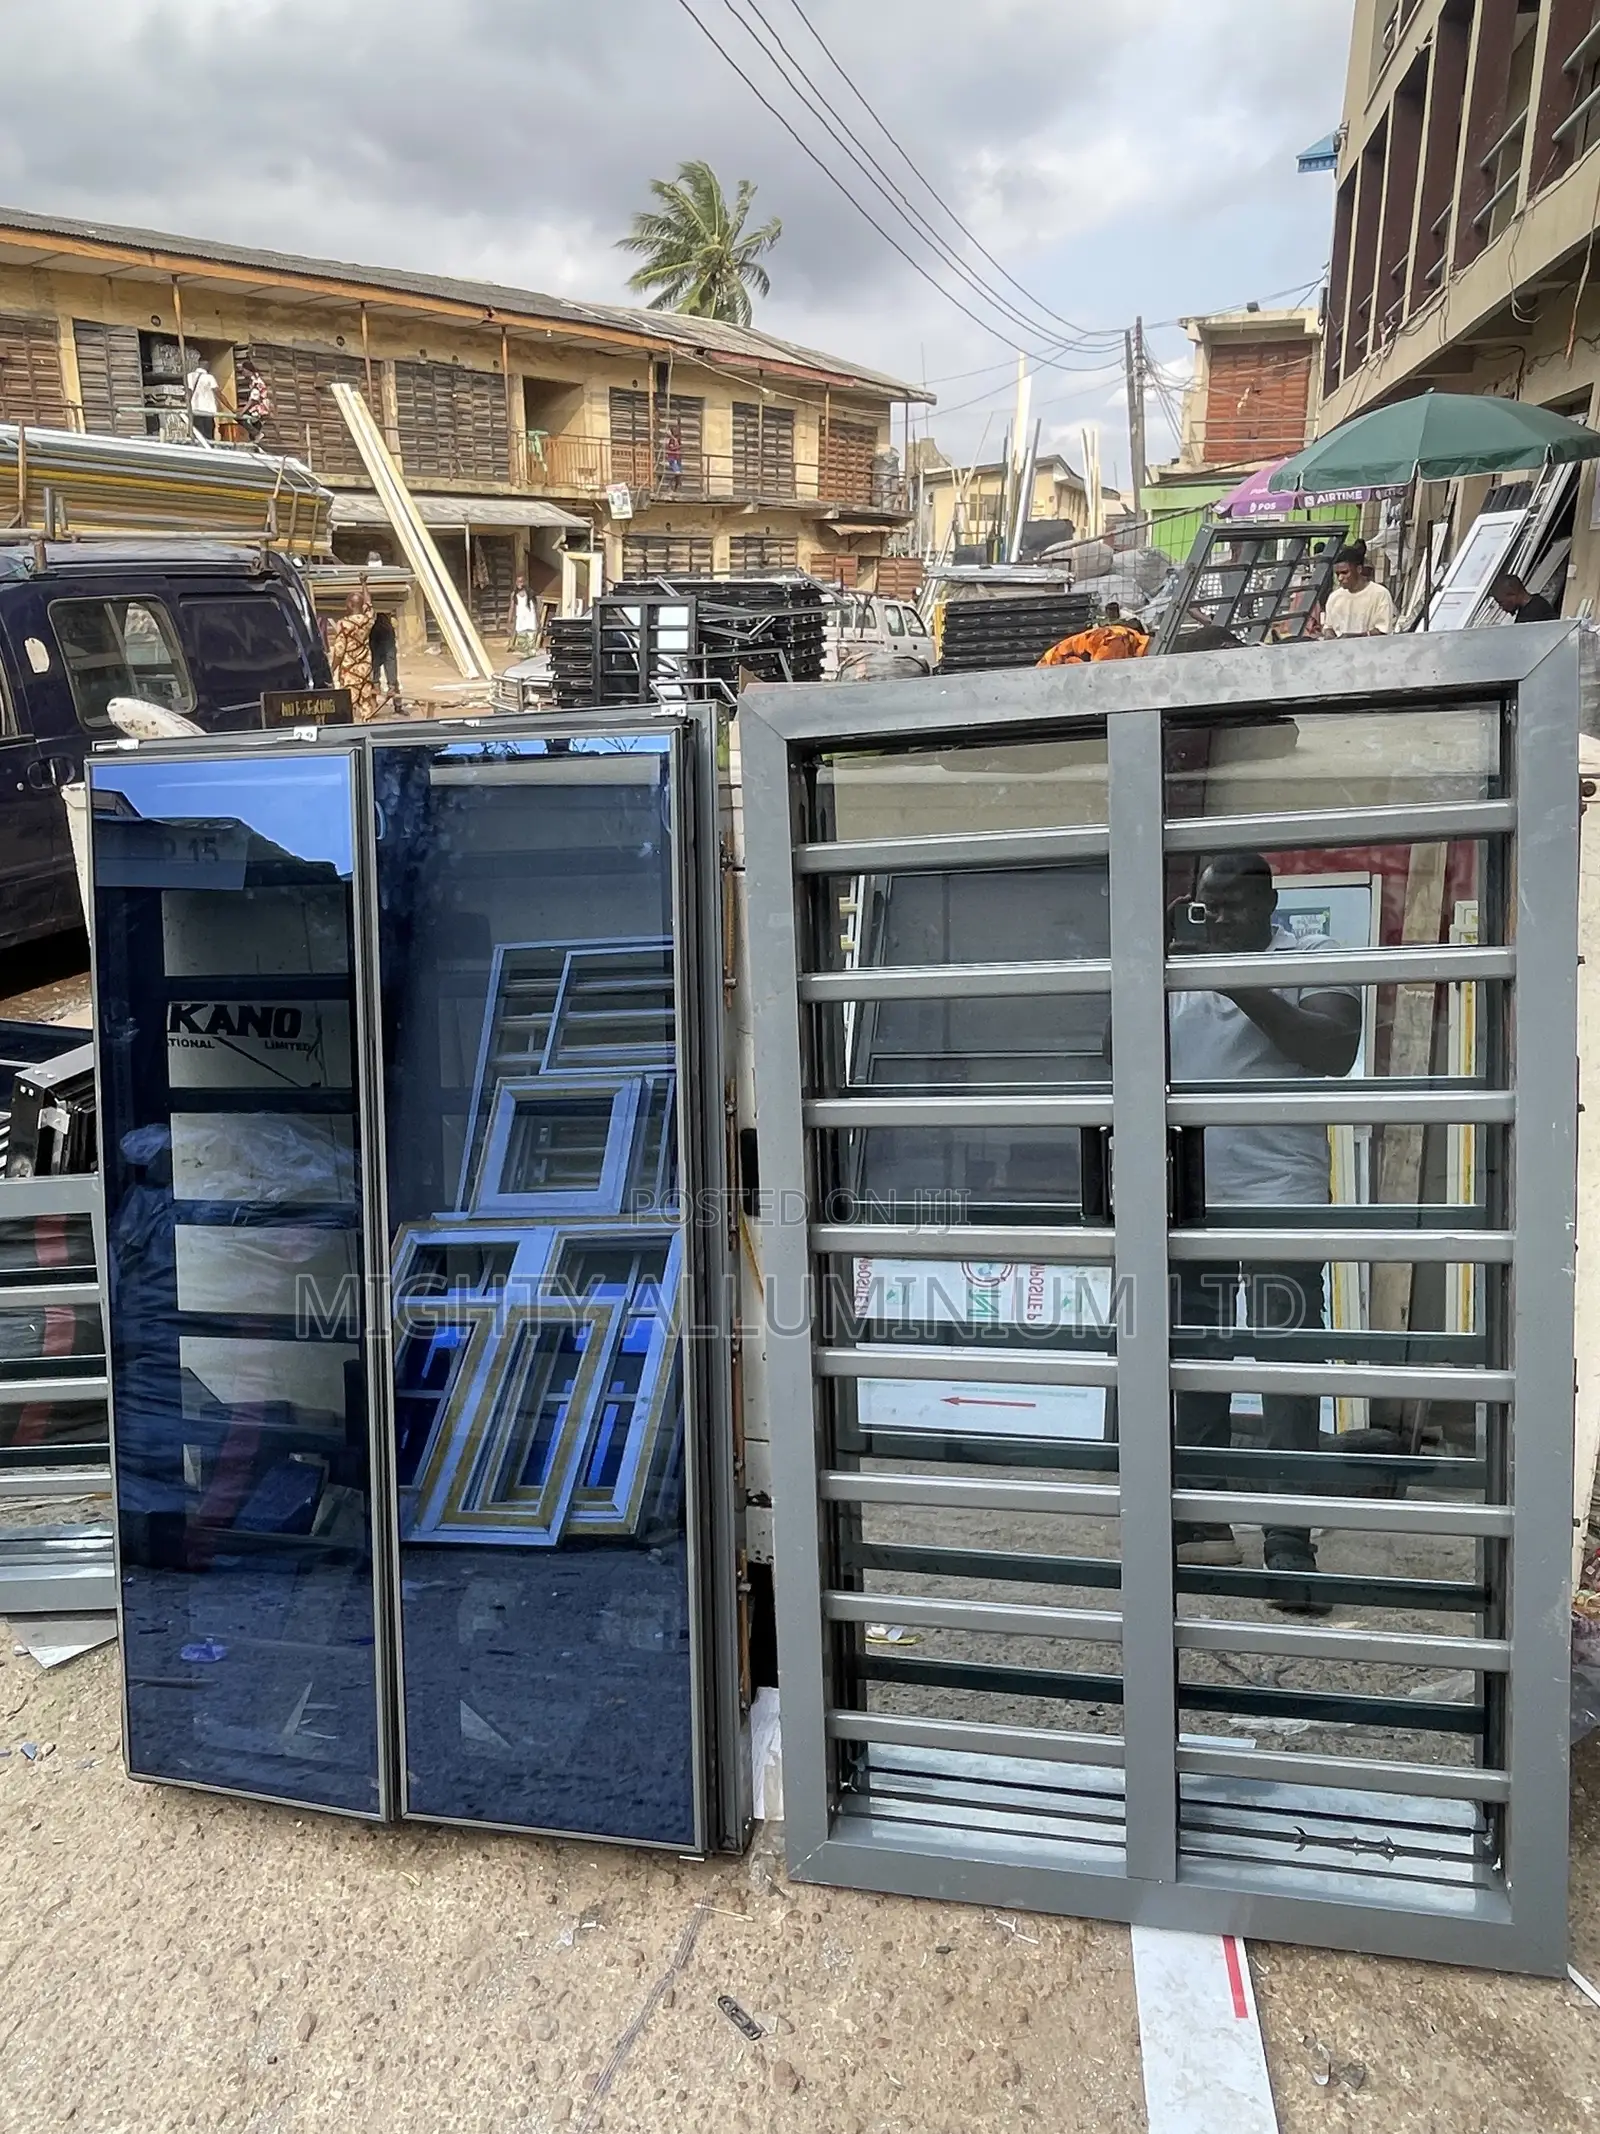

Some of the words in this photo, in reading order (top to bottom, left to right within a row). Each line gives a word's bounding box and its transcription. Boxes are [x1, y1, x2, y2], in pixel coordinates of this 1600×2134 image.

[1316, 490, 1363, 505] AIRTIME
[1258, 502, 1277, 511] POS
[167, 1037, 215, 1049] TIONAL
[264, 1040, 312, 1052] LIMITED
